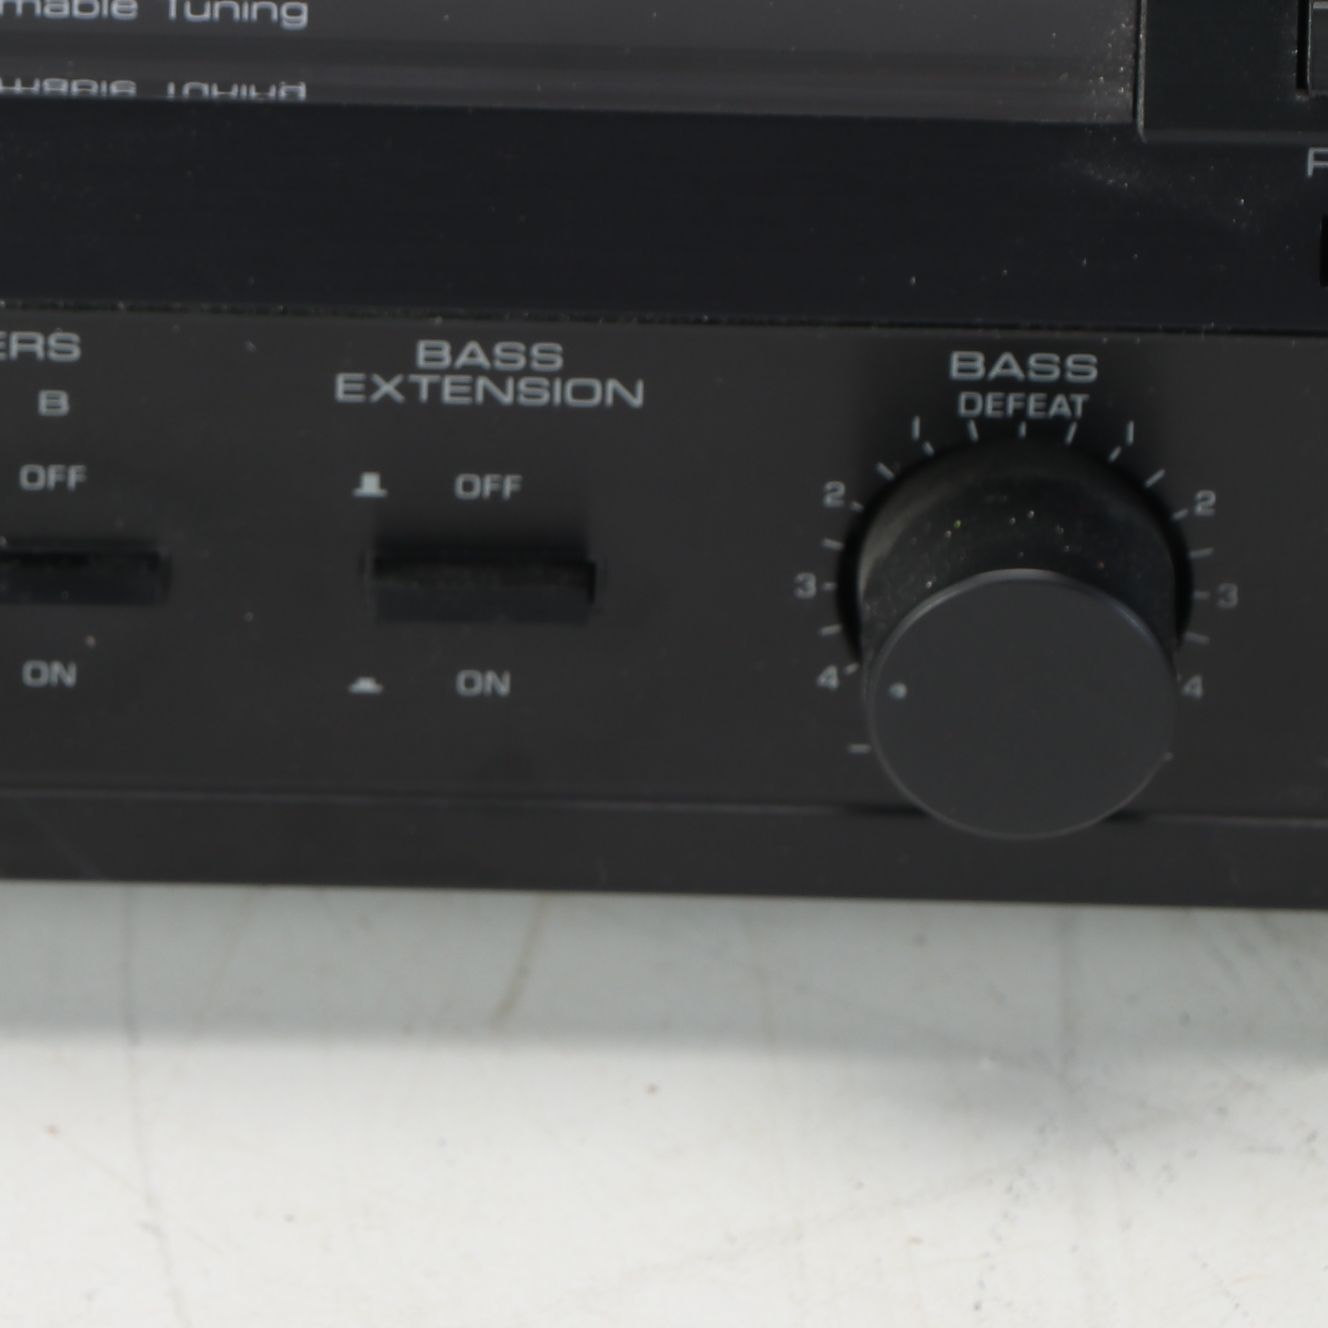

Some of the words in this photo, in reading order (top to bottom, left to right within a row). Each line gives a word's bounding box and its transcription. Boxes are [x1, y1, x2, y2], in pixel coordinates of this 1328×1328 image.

[416, 339, 564, 371] BASS
[949, 350, 1098, 382] BASS
[38, 389, 70, 416] B
[335, 372, 644, 408] EXTENSION
[957, 391, 1089, 418] DEFEAT
[19, 463, 85, 491] OFF
[454, 473, 522, 500] OFF
[823, 480, 846, 508] 2
[1194, 489, 1217, 516] 2
[795, 572, 817, 599] 3
[1217, 582, 1239, 609] 3
[22, 660, 77, 687] ON
[455, 669, 511, 697] ON
[816, 665, 840, 689] 4
[1182, 674, 1204, 699] 4
